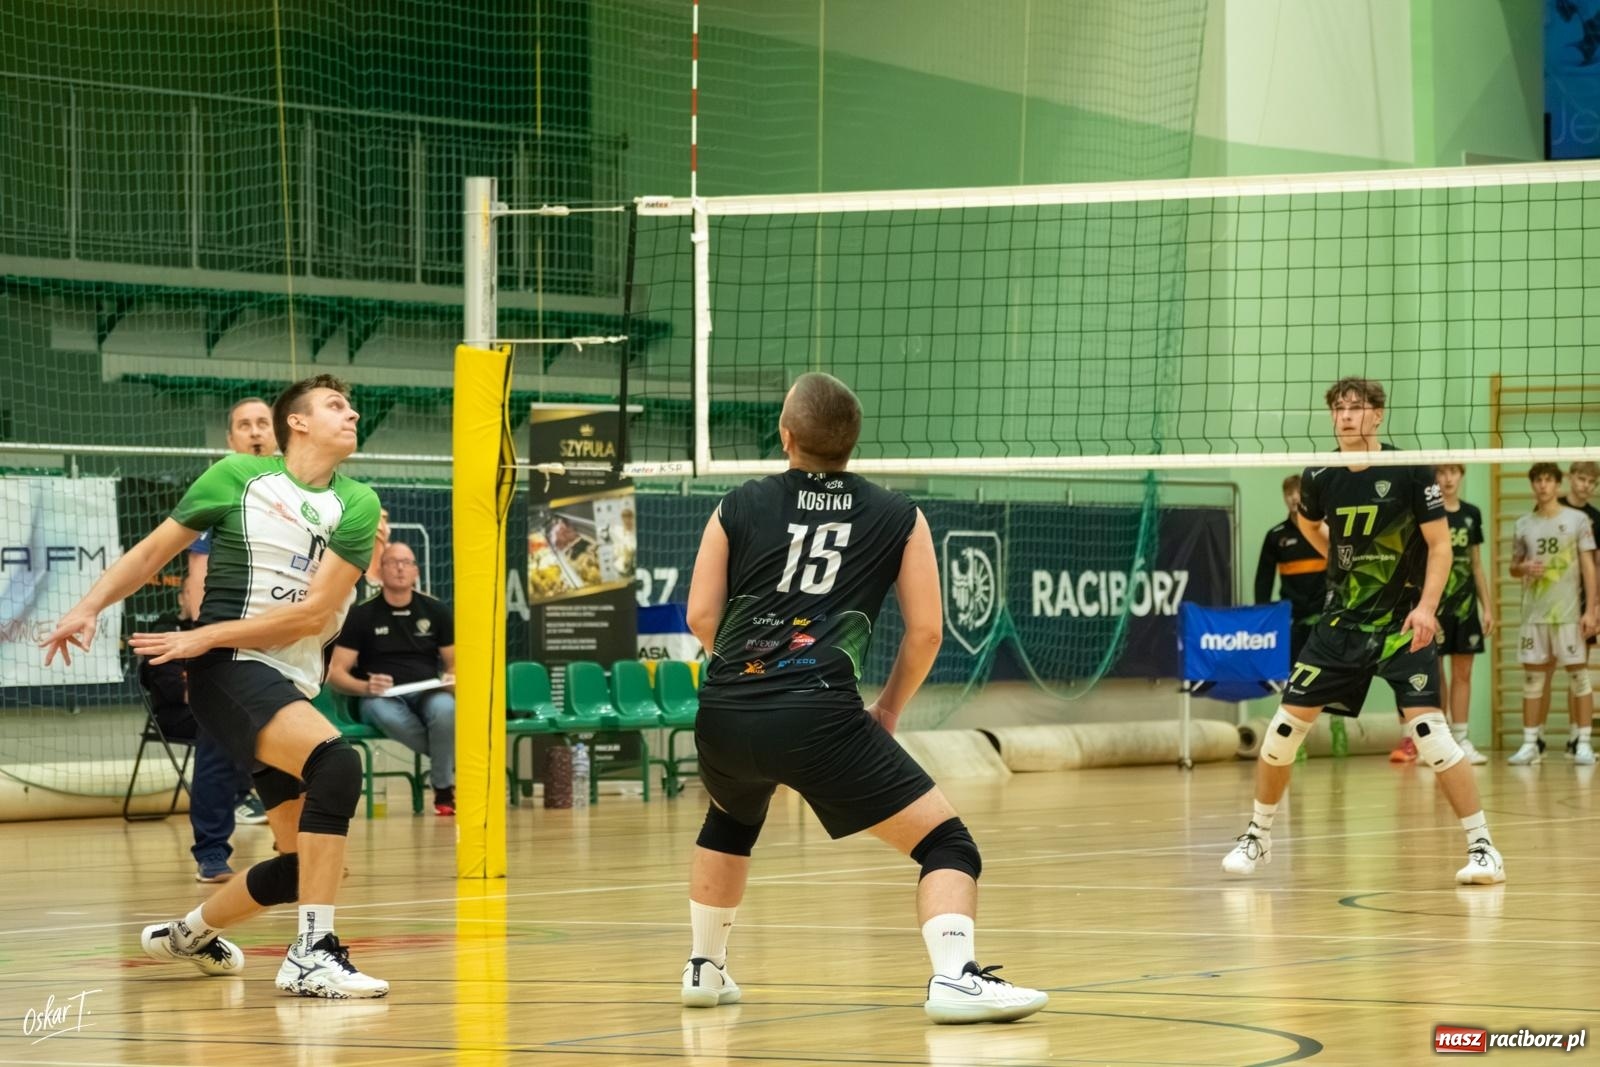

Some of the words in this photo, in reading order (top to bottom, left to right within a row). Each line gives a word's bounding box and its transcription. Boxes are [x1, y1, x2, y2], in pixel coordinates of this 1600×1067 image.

[796, 489, 853, 511] KOSTKA
[1335, 504, 1379, 538] 77
[1535, 536, 1560, 555] 38
[775, 521, 853, 595] 15
[1200, 630, 1279, 652] molten
[1288, 661, 1322, 687] 77
